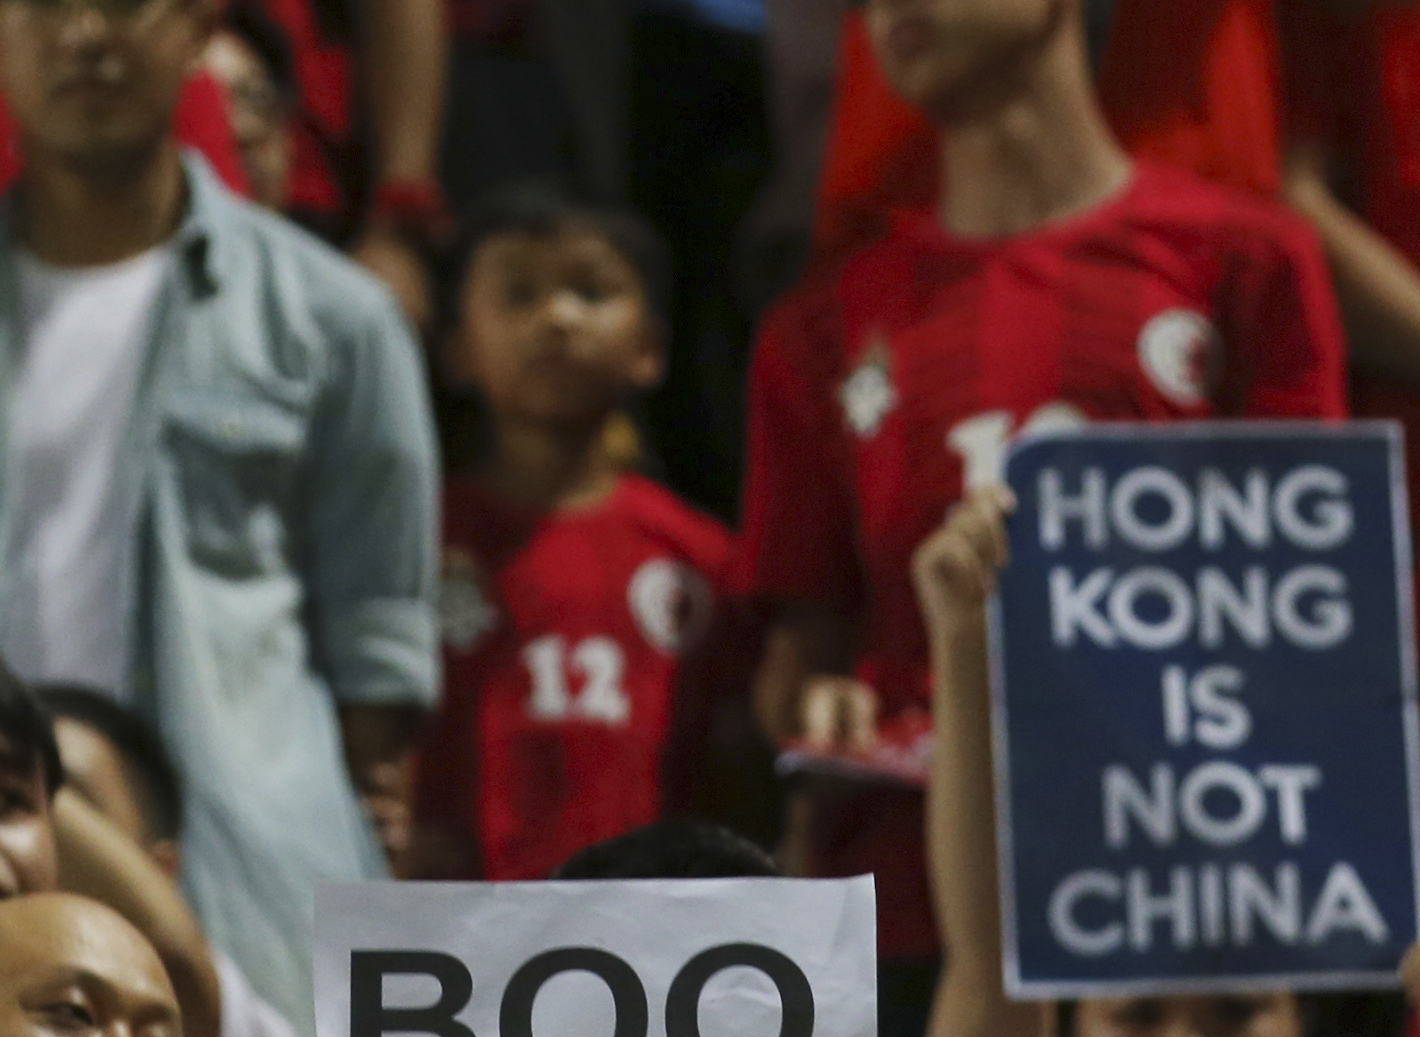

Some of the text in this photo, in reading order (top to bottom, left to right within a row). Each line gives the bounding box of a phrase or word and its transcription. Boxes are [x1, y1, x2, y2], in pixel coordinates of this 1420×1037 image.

[1037, 464, 1354, 551] HONG
[1048, 565, 1354, 649] KONG
[520, 633, 632, 727] 12
[1162, 665, 1251, 748] IS
[1103, 761, 1321, 848] NOT
[1048, 862, 1389, 956] CHINA
